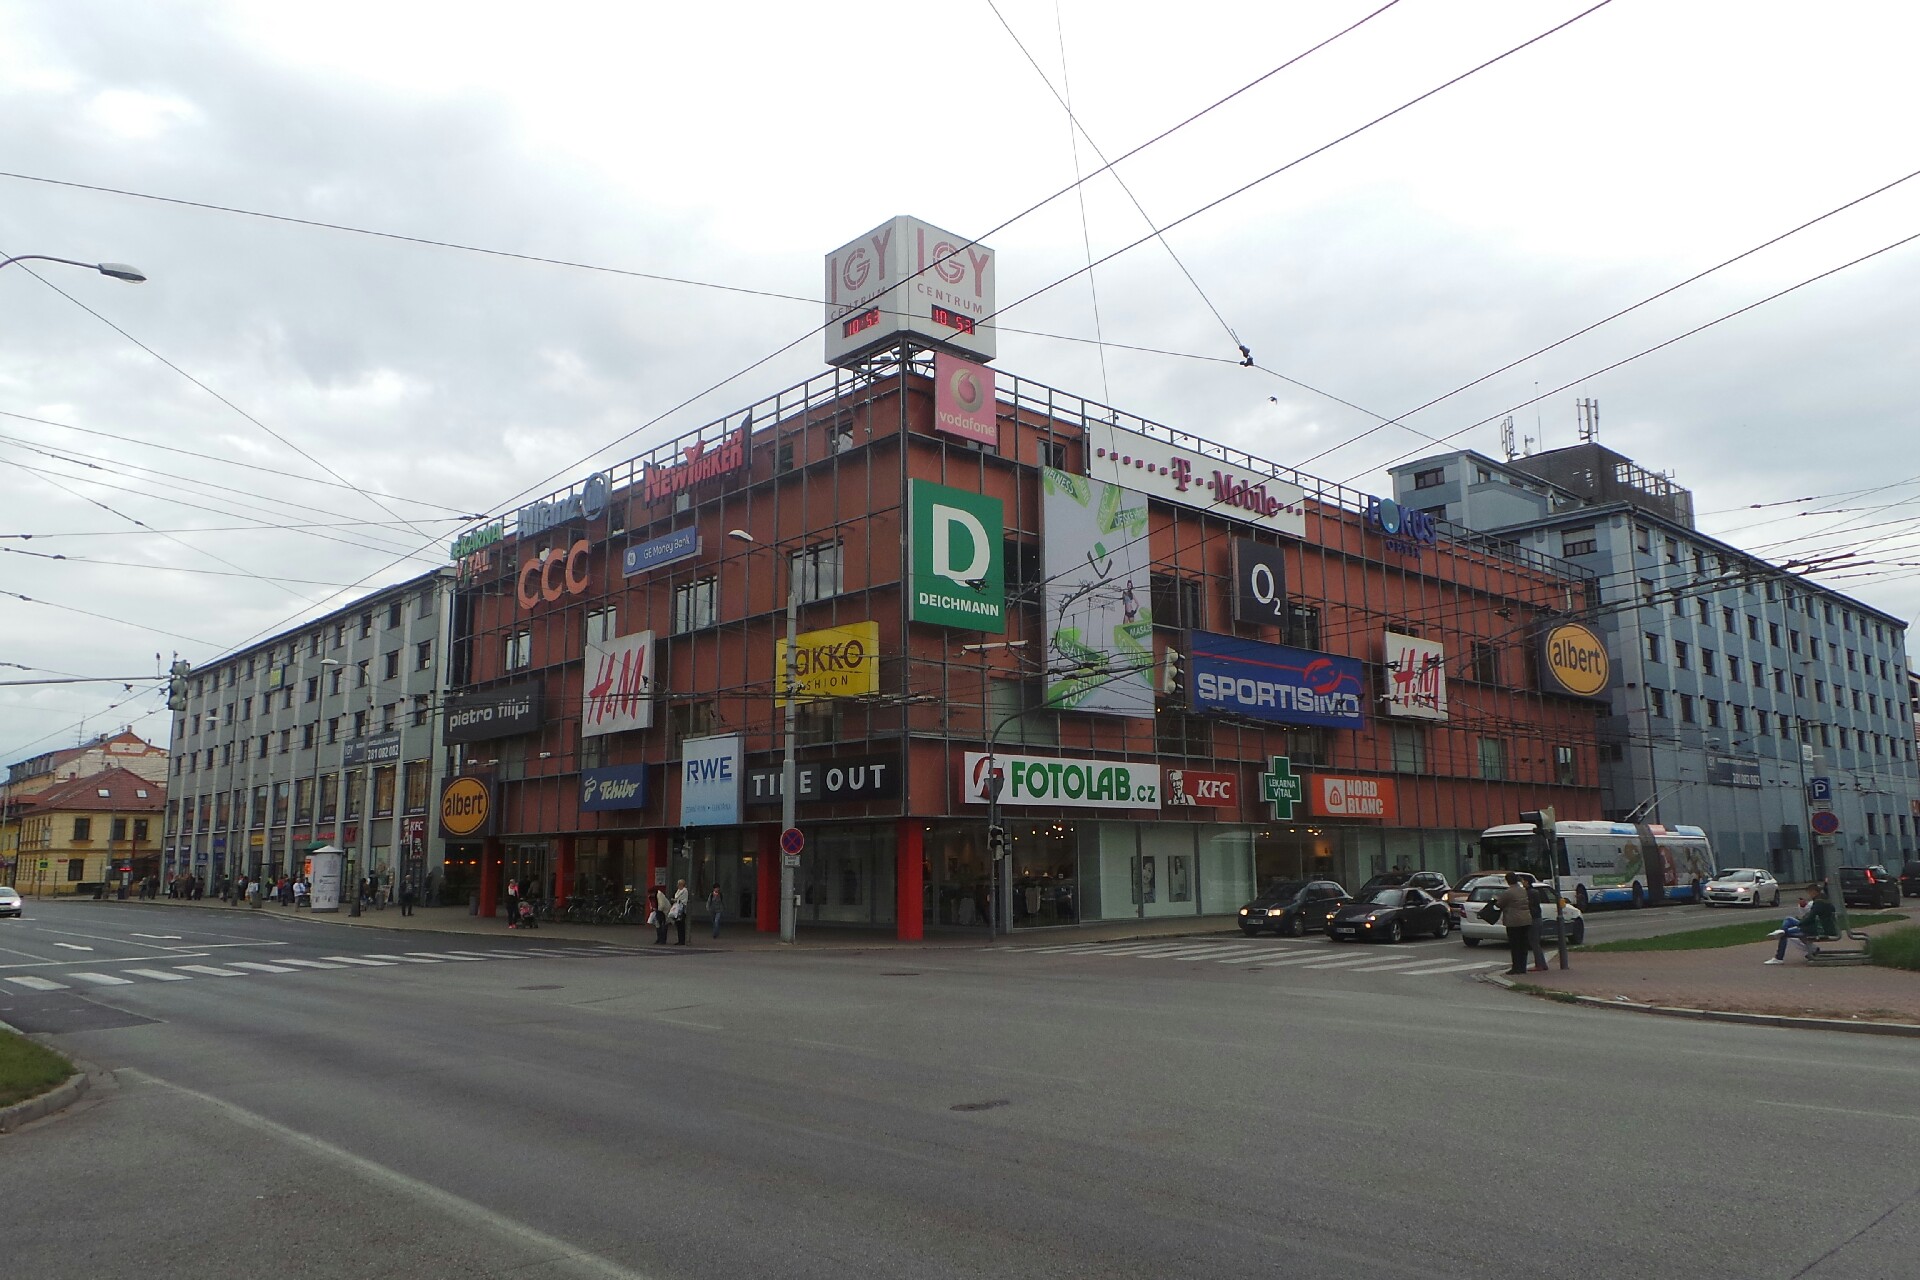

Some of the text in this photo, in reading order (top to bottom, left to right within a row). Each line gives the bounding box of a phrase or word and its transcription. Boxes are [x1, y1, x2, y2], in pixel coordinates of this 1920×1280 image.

[831, 227, 892, 304] IGY
[917, 228, 990, 298] IGY
[917, 283, 983, 314] CENTRUM
[939, 410, 995, 437] vodafone
[674, 534, 691, 549] Bank
[518, 539, 590, 609] CCC
[919, 592, 999, 617] DEICHMANN
[1553, 638, 1602, 676] albert
[587, 645, 646, 726] H&M
[449, 695, 530, 733] pietro filipi
[686, 755, 733, 782] RWE
[752, 764, 886, 797] TIE OUT
[600, 778, 641, 801] Tchibo
[1196, 779, 1232, 799] KFC
[1347, 779, 1378, 798] NORD
[445, 790, 484, 817] albert
[1347, 797, 1384, 815] BLANC
[409, 820, 424, 831] KFC
